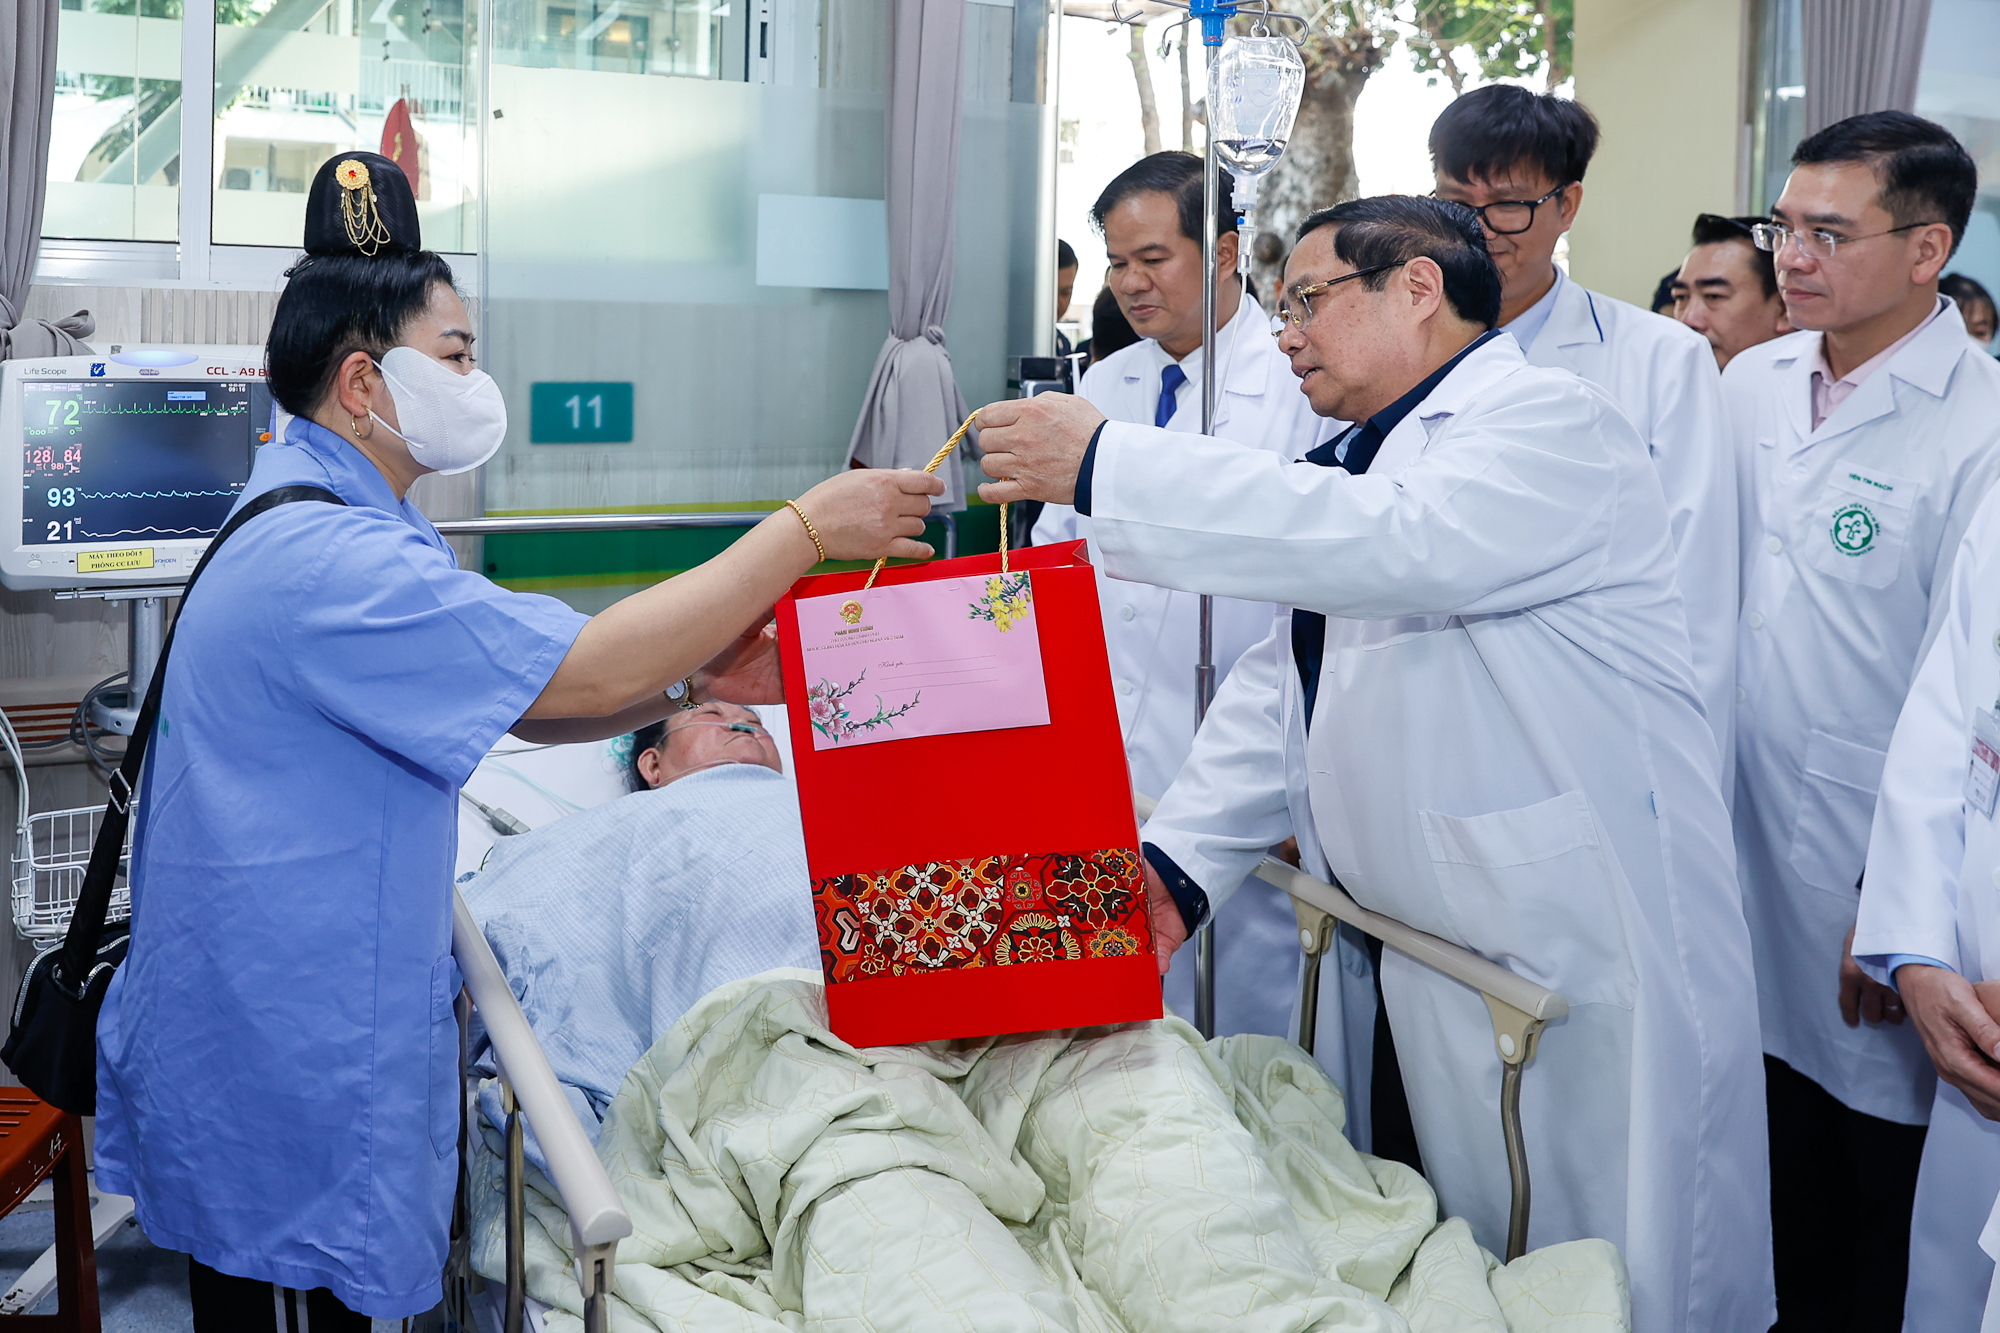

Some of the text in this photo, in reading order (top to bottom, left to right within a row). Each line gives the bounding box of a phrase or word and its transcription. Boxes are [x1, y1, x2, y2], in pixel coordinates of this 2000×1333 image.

[24, 367, 67, 376] Life Scope
[206, 367, 229, 375] CCL
[239, 368, 255, 376] A9
[45, 400, 79, 425] 72
[565, 394, 602, 429] 11
[63, 449, 82, 462] 84
[47, 487, 75, 507] 93
[47, 520, 72, 540] 21
